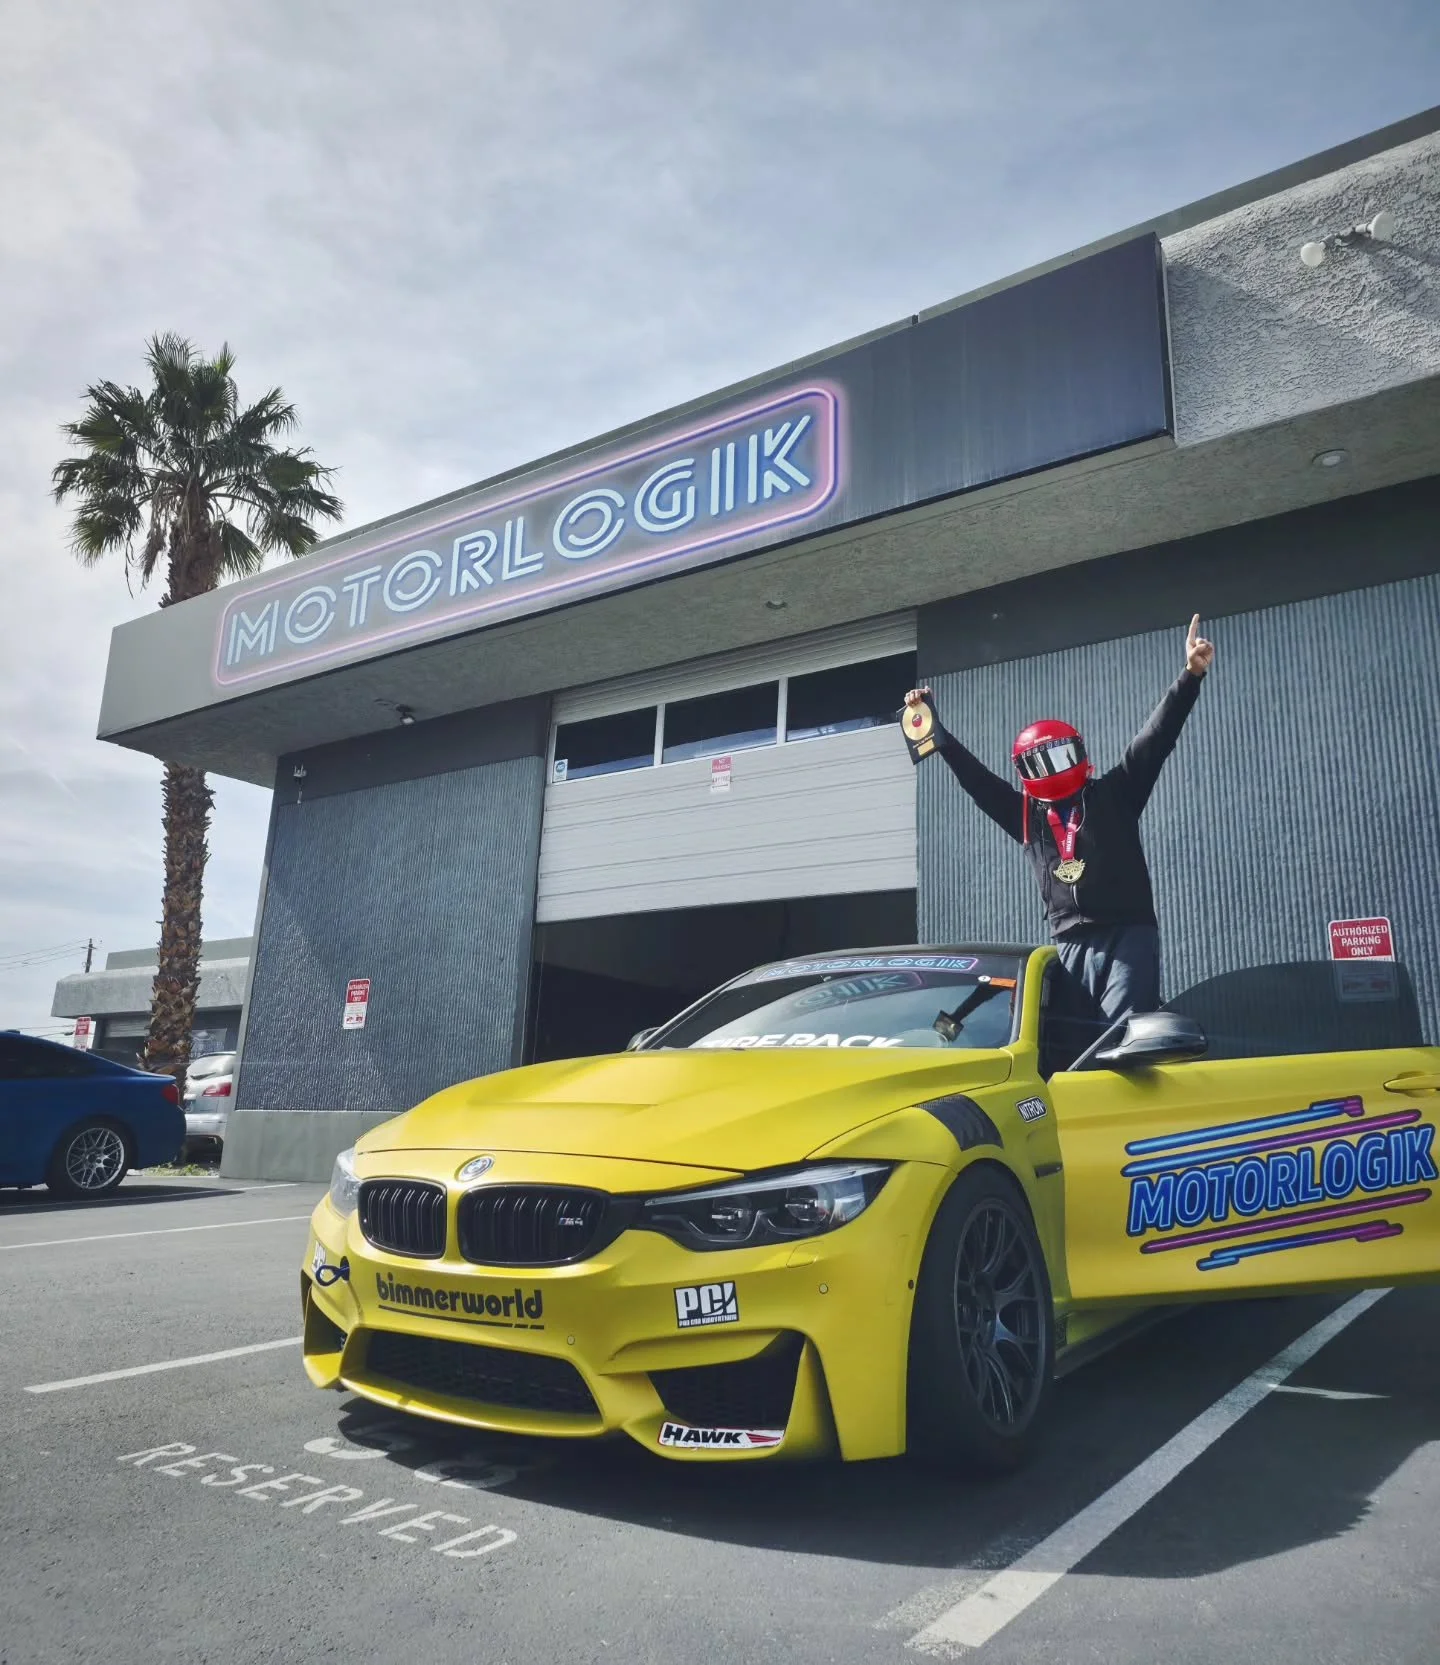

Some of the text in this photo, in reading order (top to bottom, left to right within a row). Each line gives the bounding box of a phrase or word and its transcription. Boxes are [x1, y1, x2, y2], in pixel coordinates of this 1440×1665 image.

[225, 415, 812, 666] MOTORLOGIK
[1332, 925, 1388, 937] AUTHORIZED
[1341, 935, 1381, 947] PARKING
[1350, 946, 1373, 956] ONLY
[766, 957, 972, 978] MOTORLOGIK
[1018, 1098, 1045, 1121] NITRON
[1126, 1123, 1439, 1237] MOTORLOGIK
[375, 1272, 543, 1320] bimmerworld
[663, 1424, 742, 1444] HAWK
[117, 1441, 518, 1558] RESERVED
